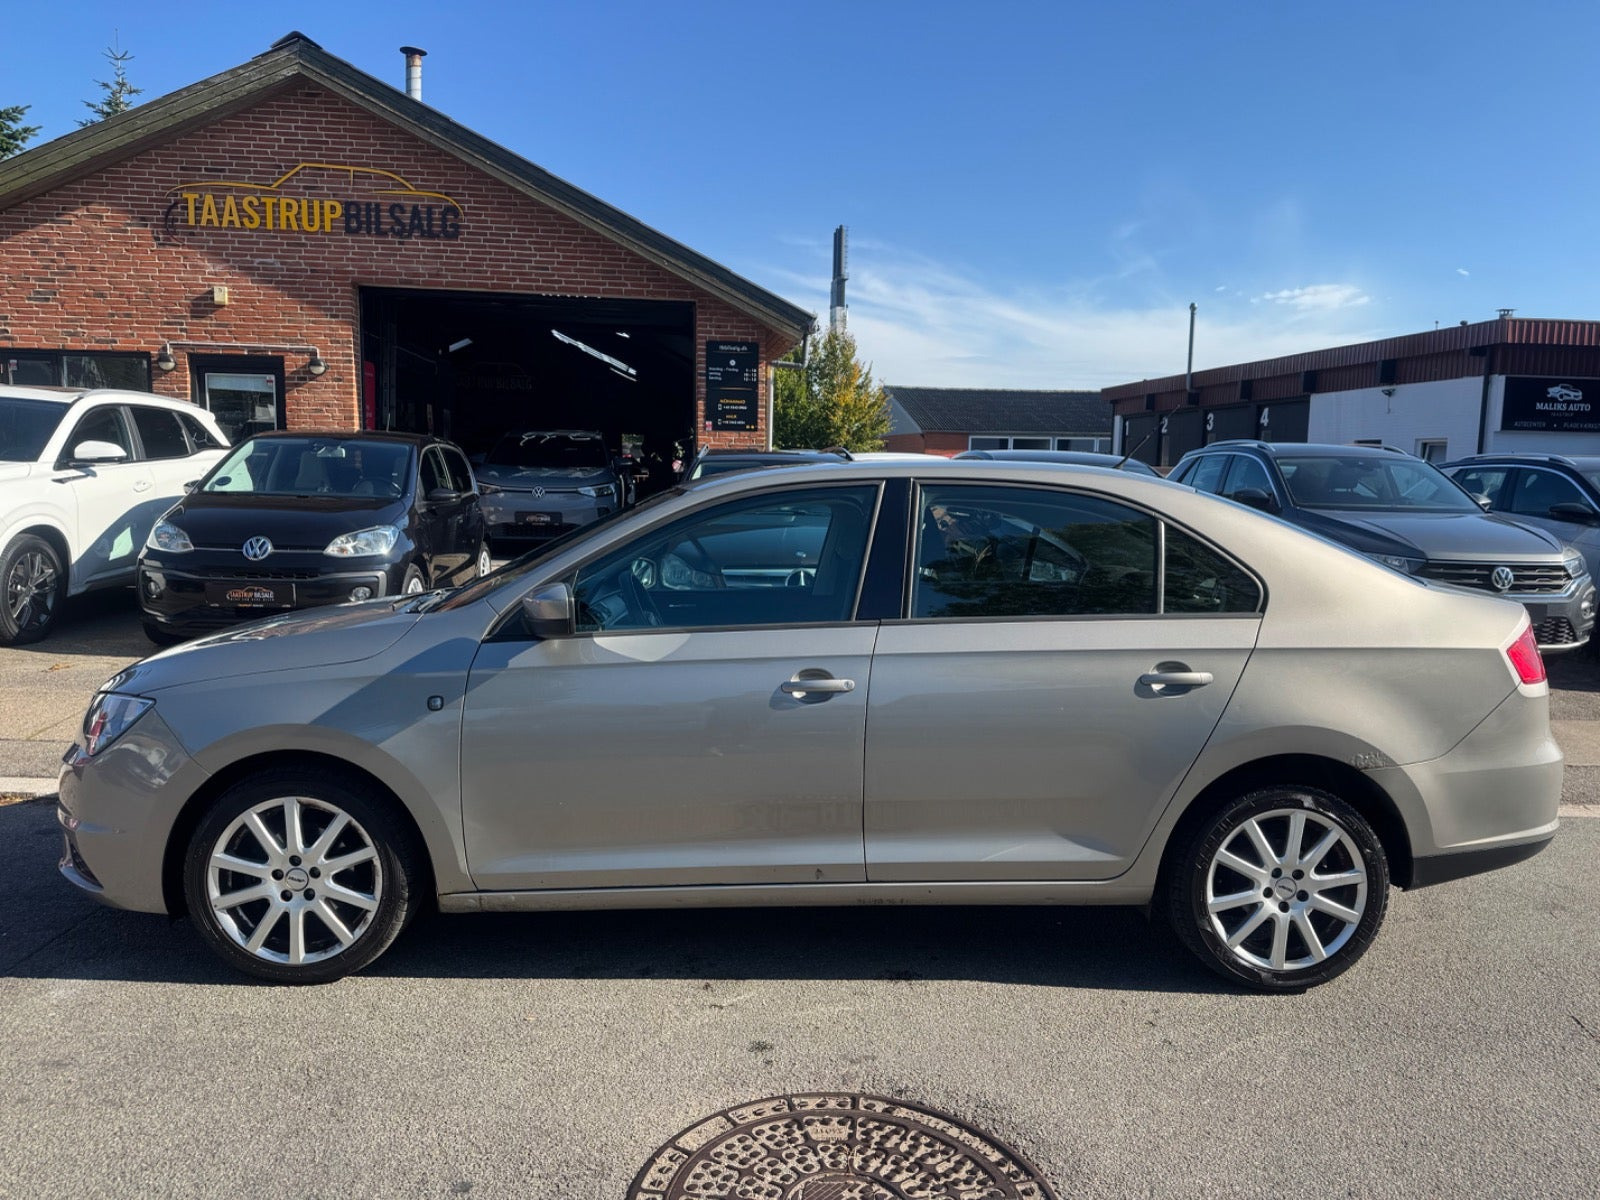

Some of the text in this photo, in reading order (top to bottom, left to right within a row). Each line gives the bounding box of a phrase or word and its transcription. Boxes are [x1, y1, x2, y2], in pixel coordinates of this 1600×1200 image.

[1535, 402, 1591, 412] MALIKS AUTO
[1161, 417, 1169, 433] 2
[1206, 413, 1214, 431] 3
[1260, 407, 1269, 427] 4
